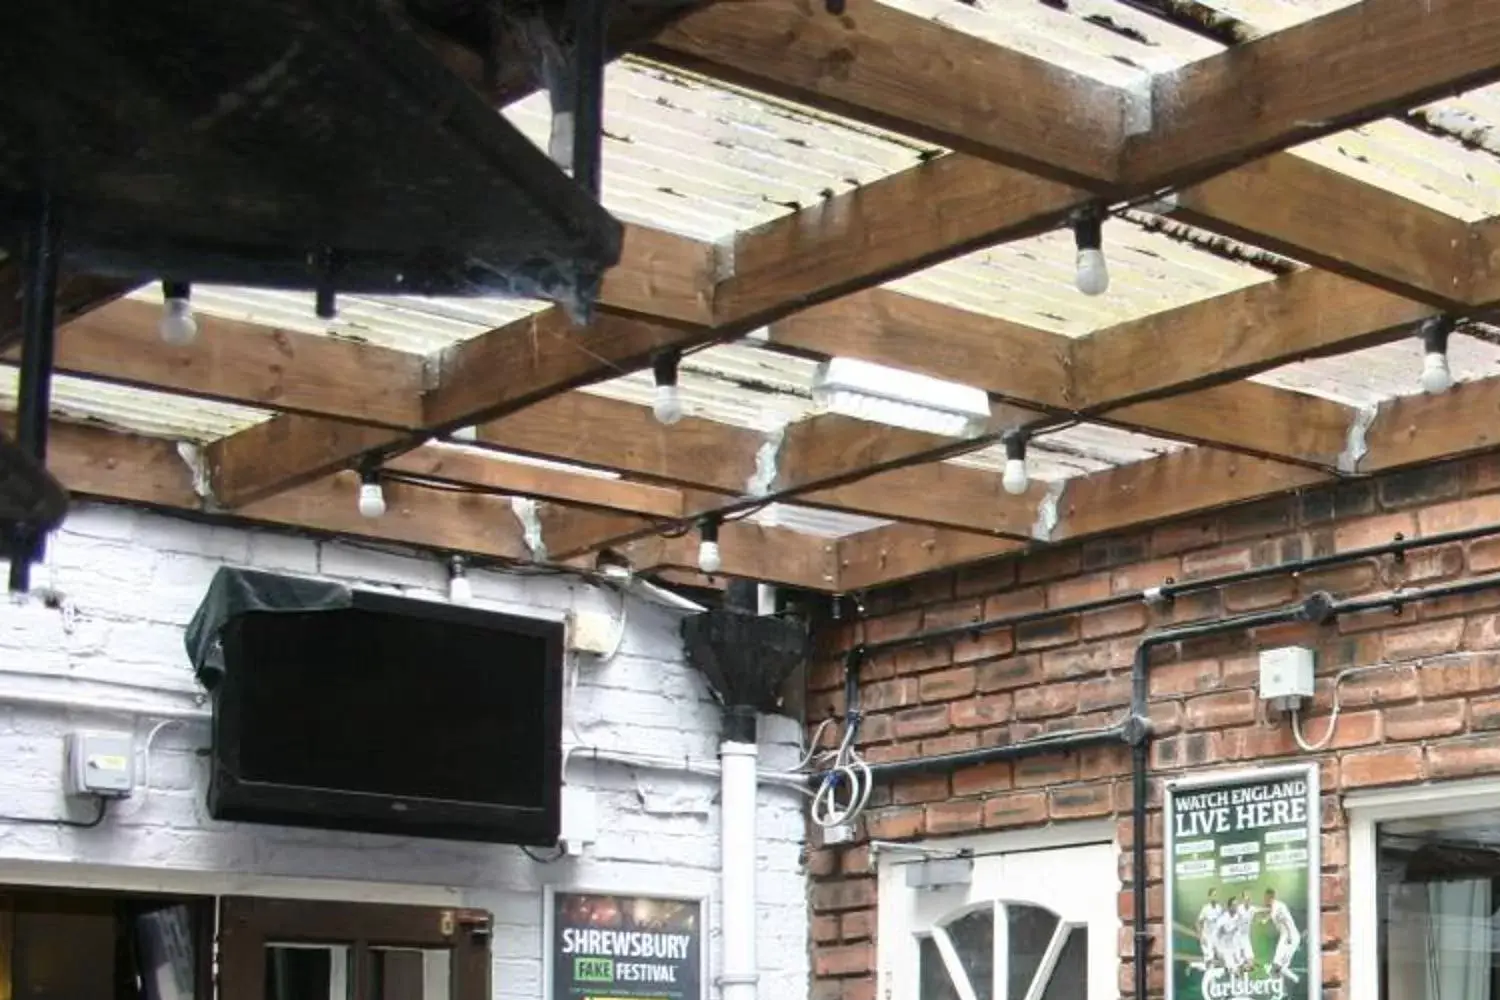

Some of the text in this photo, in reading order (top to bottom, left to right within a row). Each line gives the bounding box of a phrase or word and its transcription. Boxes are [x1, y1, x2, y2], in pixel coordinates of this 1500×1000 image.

[1175, 780, 1306, 811] WATCH ENGLAND
[1175, 798, 1307, 837] LIVE HERE
[562, 928, 691, 959] SHREWSBURY
[578, 961, 676, 983] FAKE FESTIVAL
